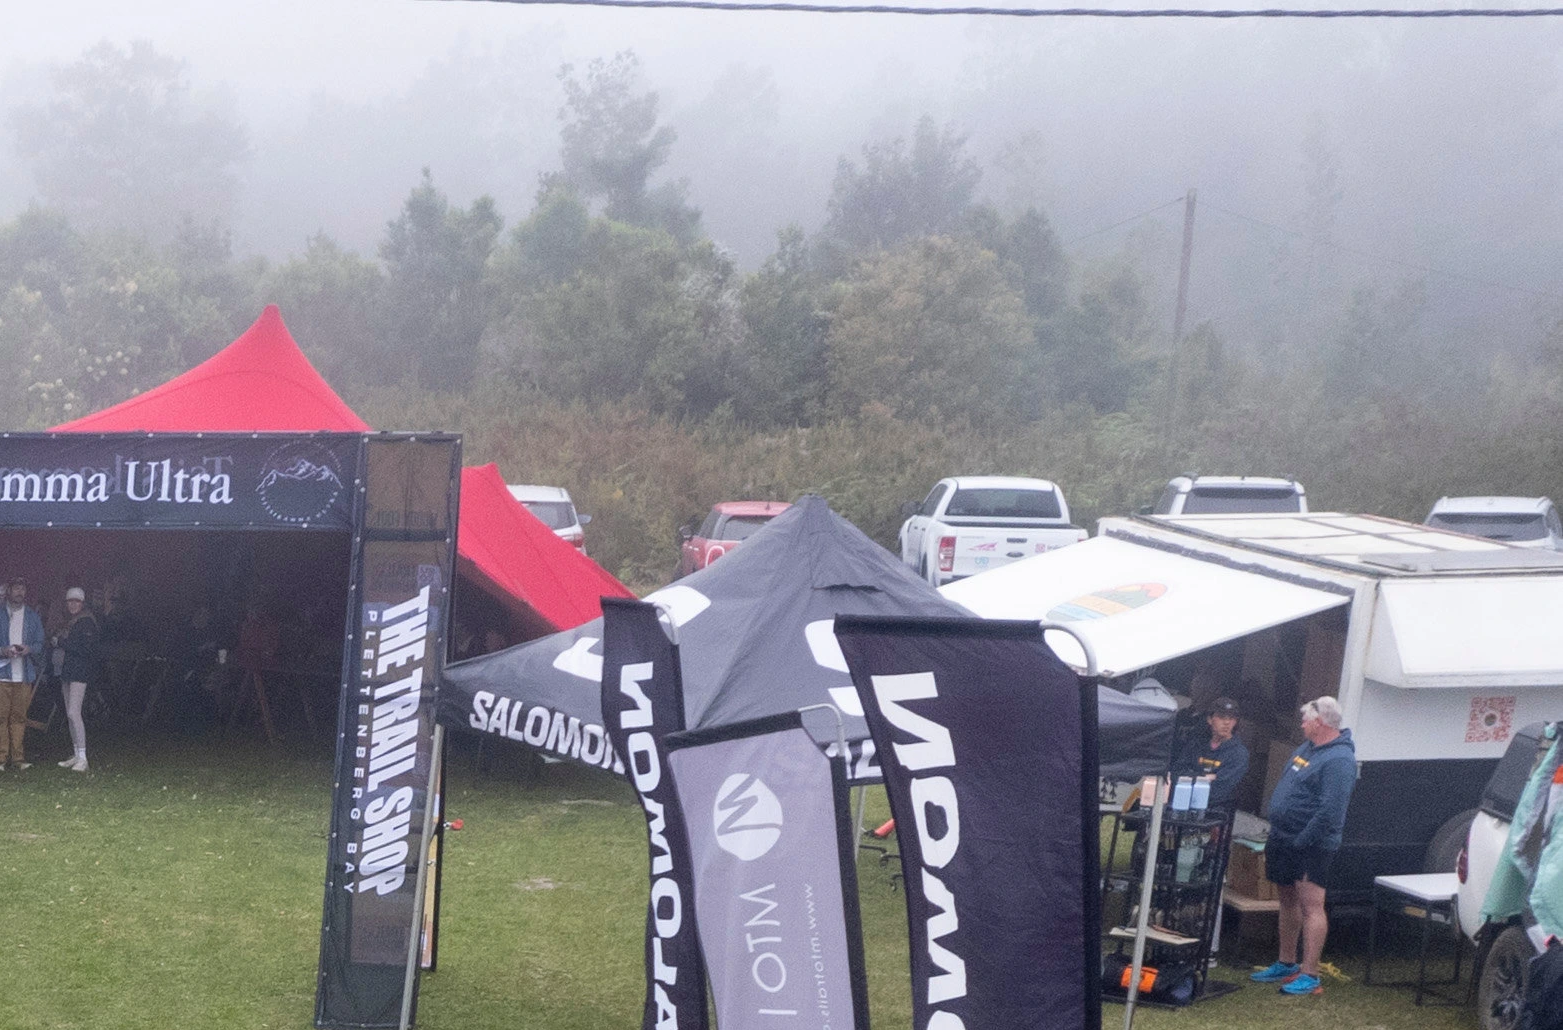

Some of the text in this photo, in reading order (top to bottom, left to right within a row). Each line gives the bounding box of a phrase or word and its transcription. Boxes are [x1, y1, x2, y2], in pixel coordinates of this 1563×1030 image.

[125, 458, 234, 504] Ultra
[376, 585, 430, 676] THE
[343, 610, 378, 893] PLETTENBERG BAY
[367, 667, 424, 793] TRAIL
[469, 690, 626, 775] SALOMON
[358, 786, 414, 896] SHOP
